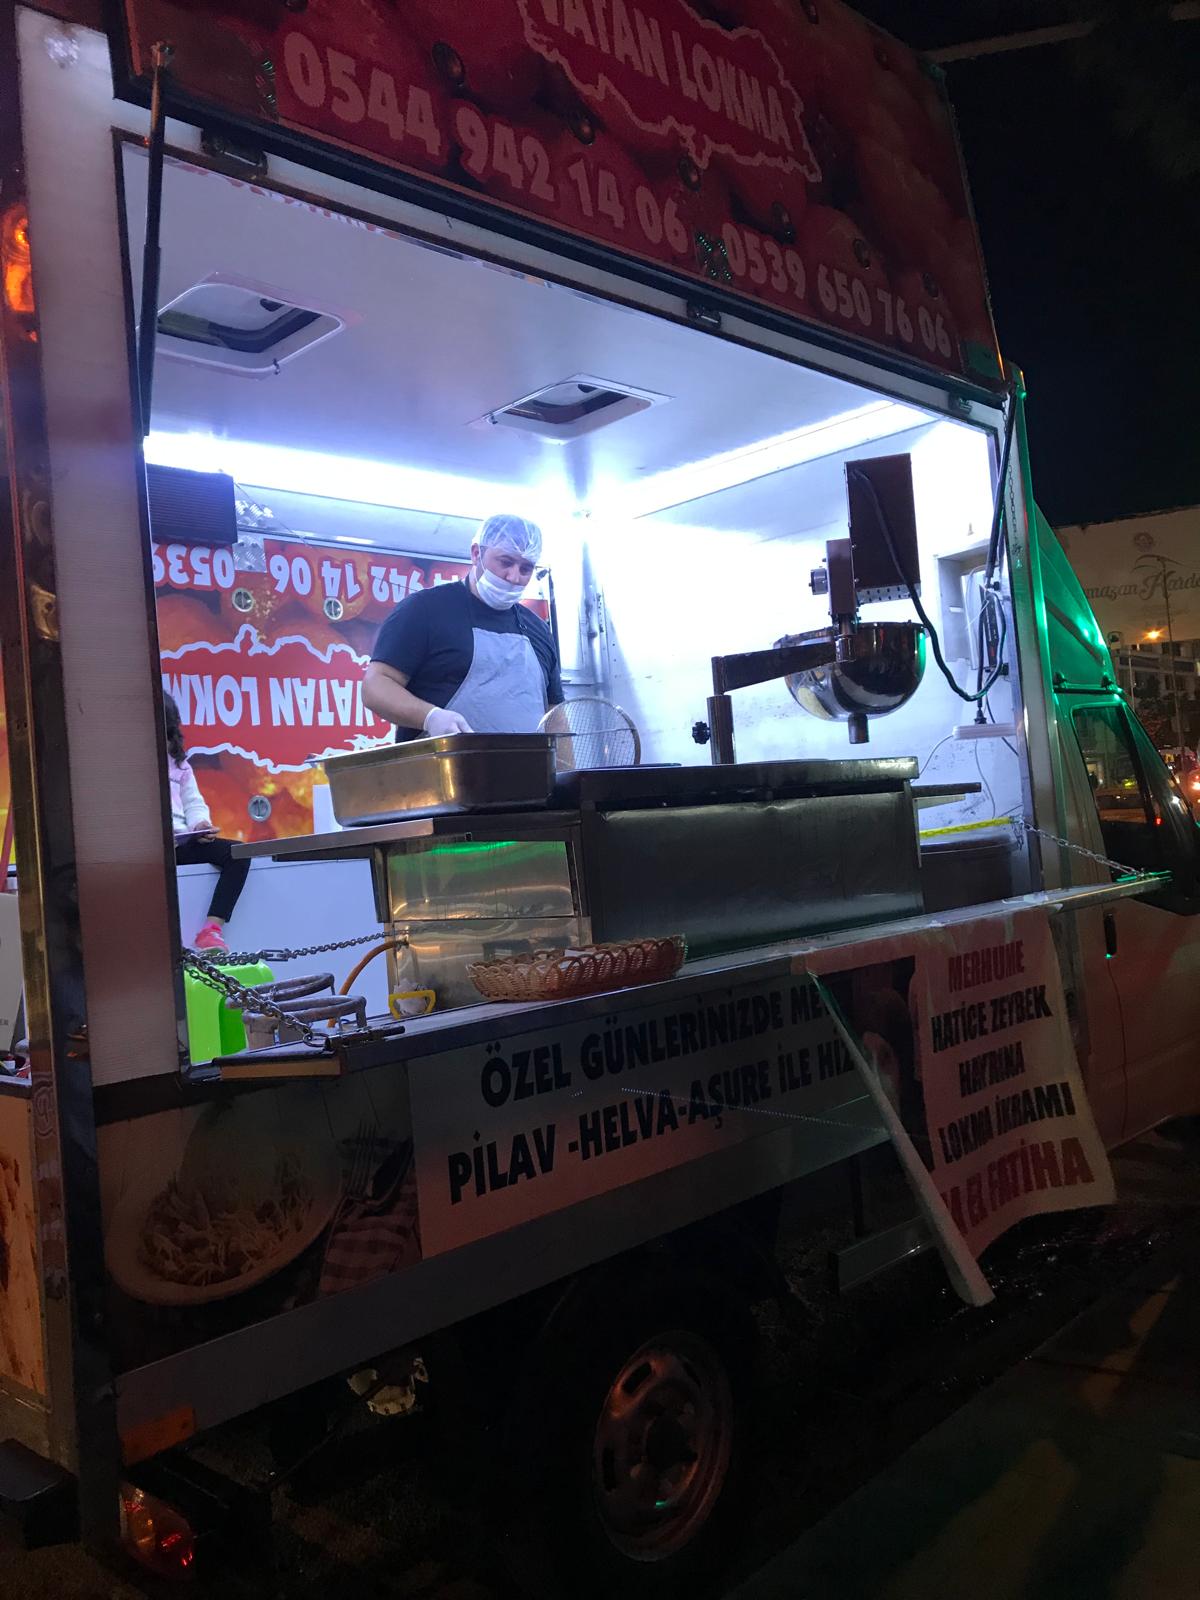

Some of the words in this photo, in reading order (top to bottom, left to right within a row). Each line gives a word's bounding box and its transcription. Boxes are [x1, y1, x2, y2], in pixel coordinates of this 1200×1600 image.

[671, 30, 795, 151] LOKMA
[283, 31, 442, 156] 0544
[455, 107, 555, 201] 942
[568, 157, 626, 229] 14
[634, 185, 690, 254] 06
[721, 222, 806, 300] 0539
[817, 263, 873, 327] 650
[876, 287, 914, 344] 76
[917, 306, 951, 359] 06
[269, 554, 312, 596] 06
[321, 560, 361, 600] 14
[161, 673, 260, 728] LOKM
[948, 940, 1025, 993] MERHUME
[480, 1041, 572, 1107] ÖZEL
[580, 989, 784, 1080] GÜNLERİNİZDE
[931, 1001, 989, 1054] HATİCE
[991, 984, 1053, 1033] ZEYBEK
[447, 1124, 556, 1206] PİLAV
[777, 1042, 813, 1093] İLE
[938, 1105, 994, 1164] LOKMA
[995, 1081, 1076, 1136] İKRAMI
[987, 1137, 1096, 1212] FATİHA
